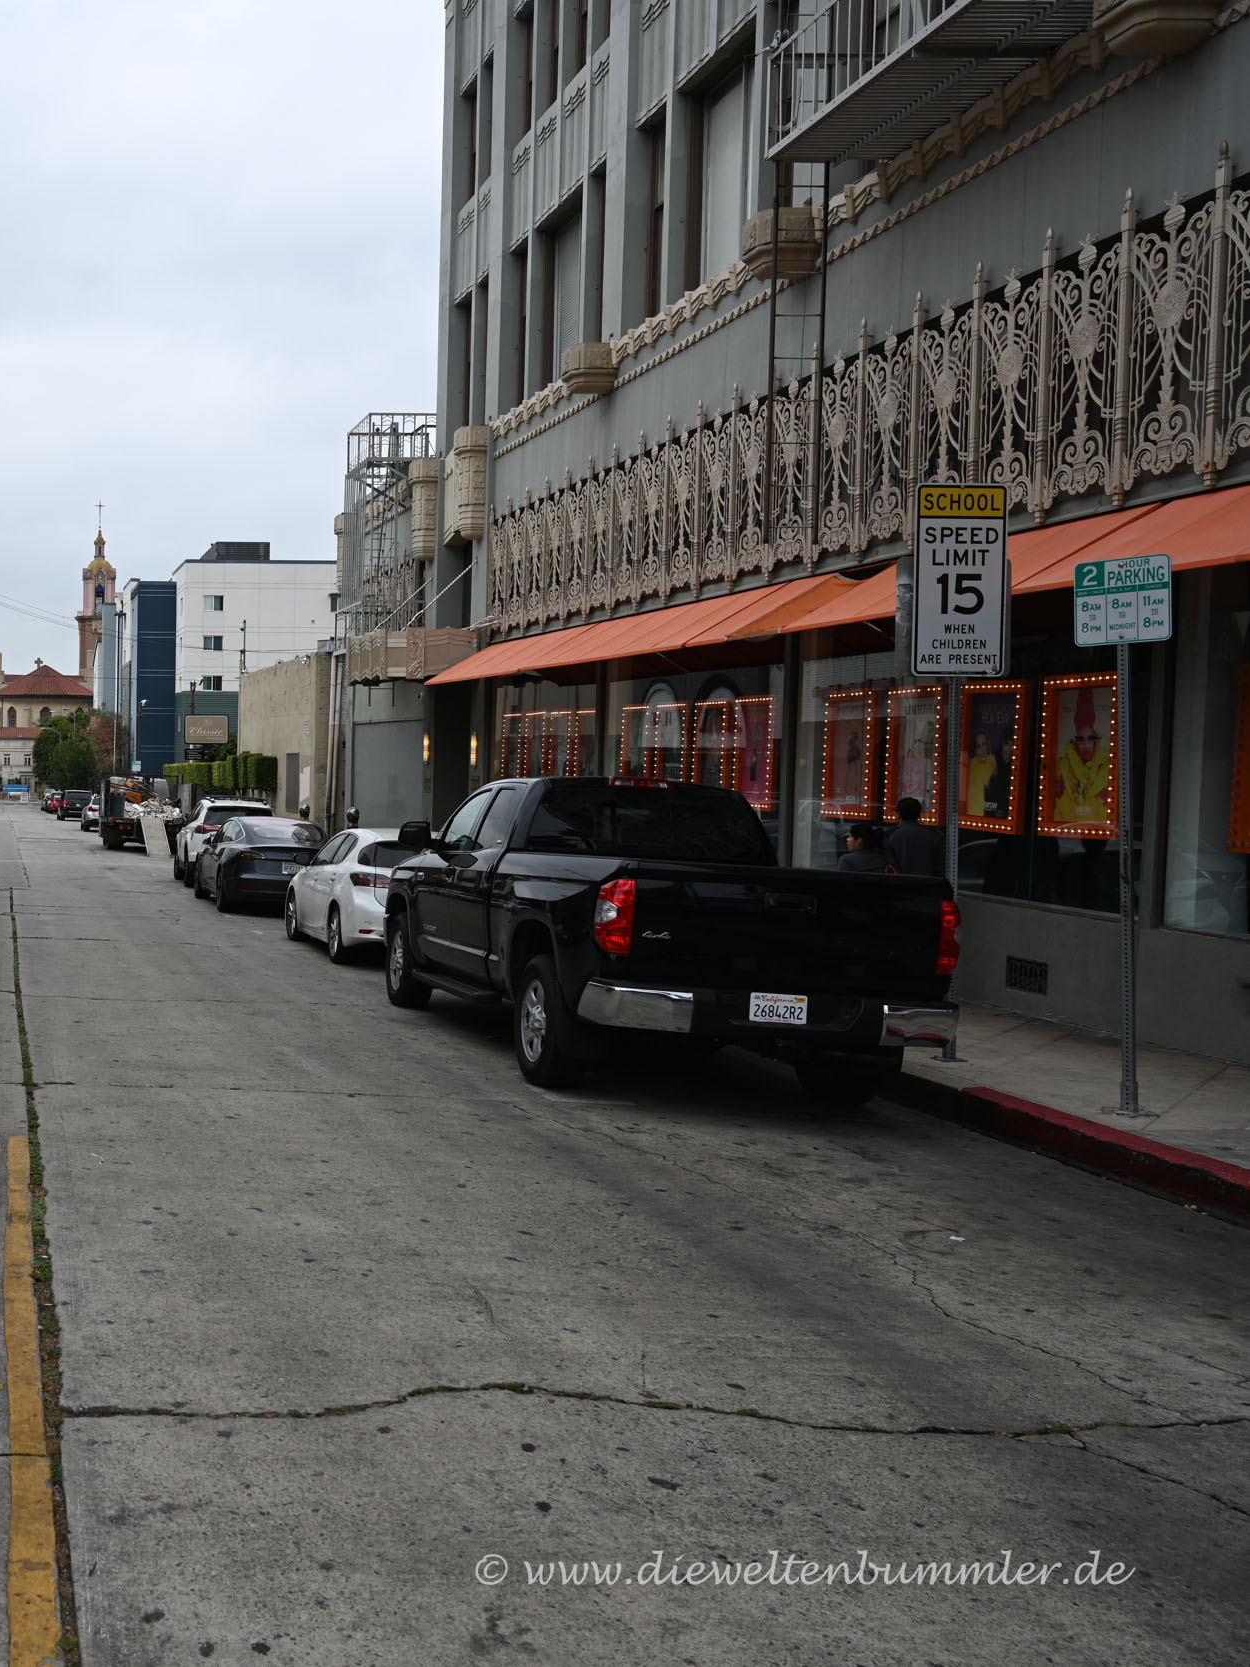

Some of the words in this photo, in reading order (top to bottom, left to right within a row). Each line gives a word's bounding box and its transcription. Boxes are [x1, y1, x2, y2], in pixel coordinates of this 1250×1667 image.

[924, 493, 1000, 511] SCHOOL
[924, 527, 999, 544] SPEED
[932, 549, 989, 566] LIMIT
[1122, 558, 1150, 568] HOUR
[1083, 565, 1097, 586] 2
[1108, 566, 1165, 586] PARKING
[936, 573, 984, 615] 15
[944, 624, 975, 634] WHEN
[1109, 622, 1136, 630] MIDNIGHT
[932, 639, 986, 649] CHILDREN
[920, 654, 941, 664] ARE
[949, 654, 997, 665] PRESENT
[189, 727, 223, 735] Classic
[761, 994, 794, 1004] California
[753, 1004, 803, 1020] 26842R2
